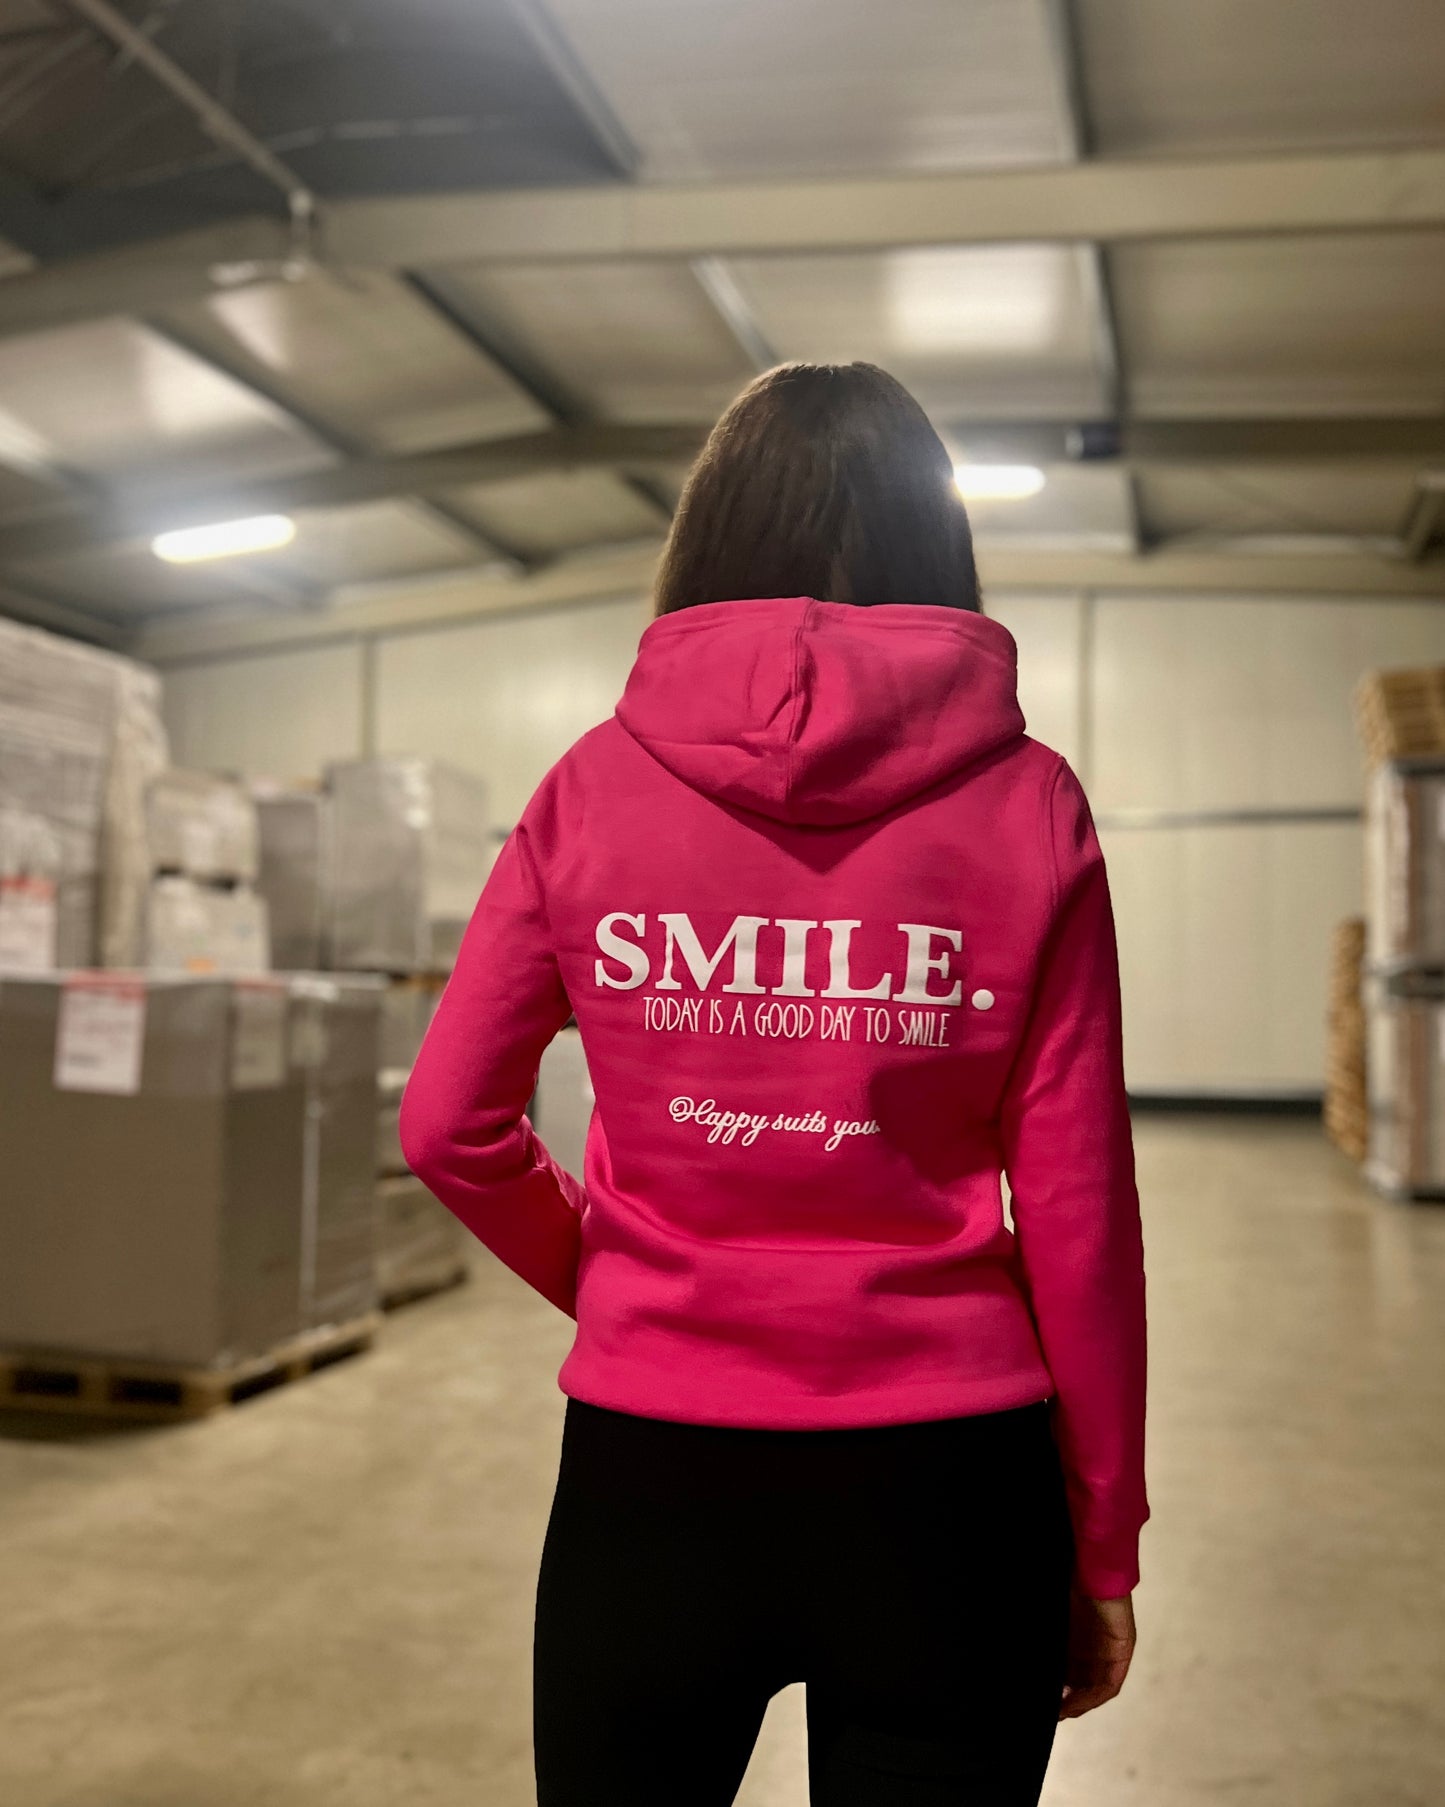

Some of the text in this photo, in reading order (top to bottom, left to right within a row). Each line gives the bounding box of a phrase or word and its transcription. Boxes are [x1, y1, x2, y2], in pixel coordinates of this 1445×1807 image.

[594, 911, 995, 1011] SMILE.
[642, 996, 950, 1047] TODAY IS A GOOD DAY TO SMILE
[668, 1096, 770, 1147] Happy
[770, 1110, 828, 1133] suits
